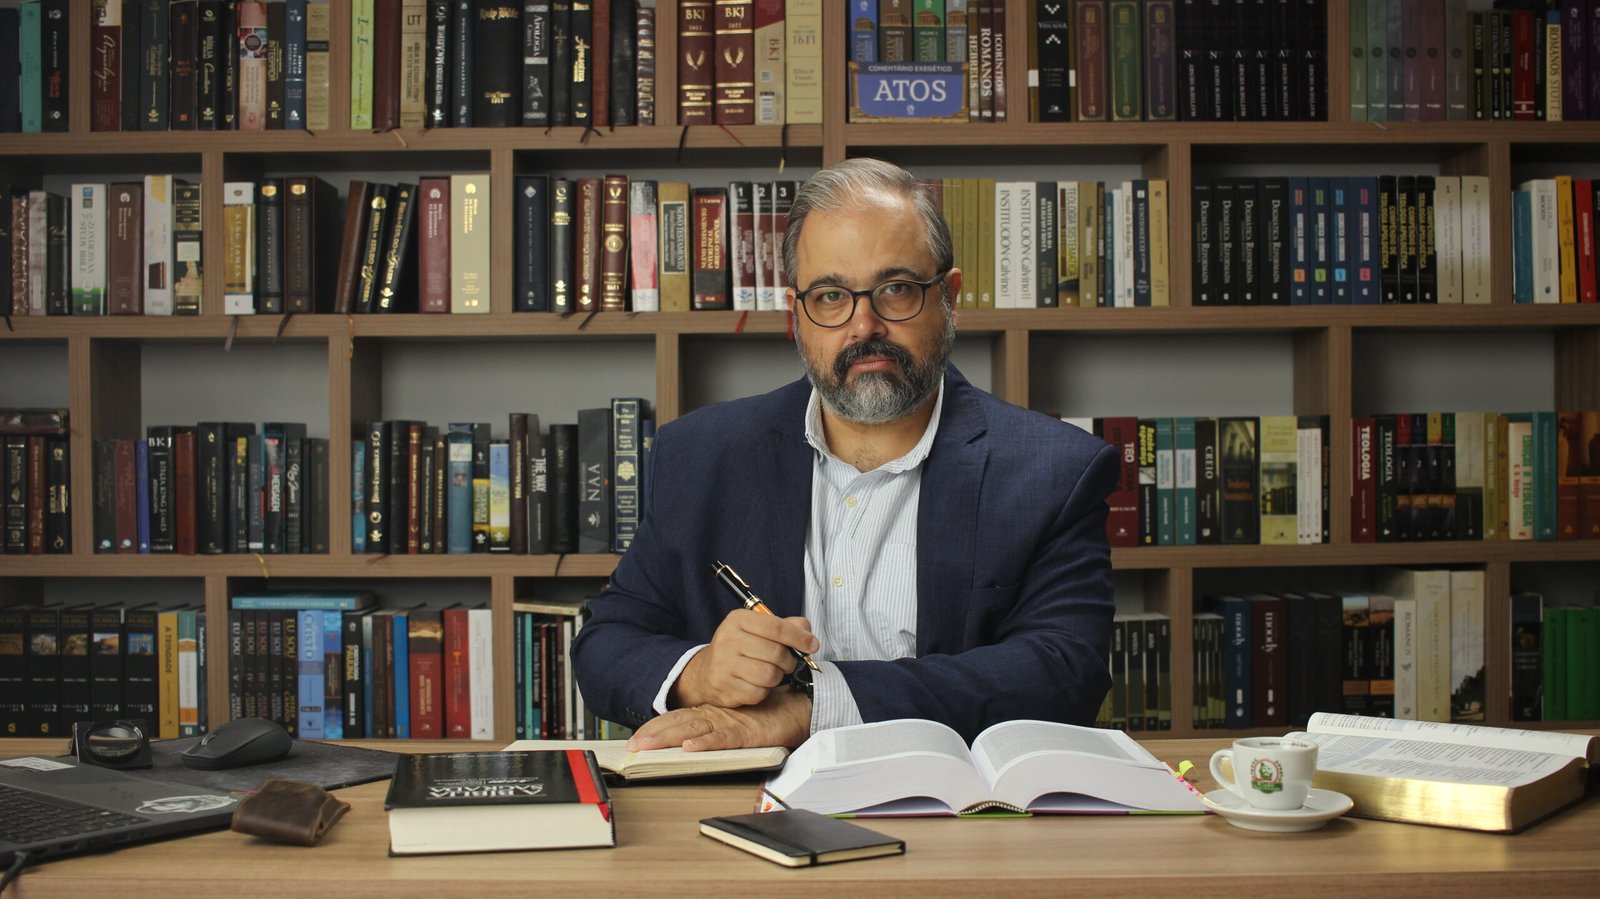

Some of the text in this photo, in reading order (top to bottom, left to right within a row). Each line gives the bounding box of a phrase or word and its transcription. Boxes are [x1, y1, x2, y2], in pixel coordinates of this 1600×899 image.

[685, 9, 705, 21] BKJ
[725, 7, 744, 19] BKJ
[533, 14, 543, 57] APOLOGIA
[767, 37, 781, 62] BKJ
[793, 34, 816, 46] 1611
[868, 64, 953, 72] COMENTÁRIO EXEGÉTICO
[968, 35, 978, 89] HEBREUS
[981, 27, 992, 97] ROMANOS
[1549, 26, 1561, 110] ROMANOS STOTT
[872, 79, 948, 102] ATOS
[738, 187, 744, 197] 1
[780, 187, 787, 197] 3
[1067, 187, 1077, 224] TEOLOGIA
[1000, 190, 1012, 255] INSTITUCIÓN
[1020, 189, 1033, 255] INSTITUCIÓN
[87, 220, 96, 274] ZONDERVAN
[1000, 257, 1011, 293] Calvino
[1020, 257, 1032, 292] Calvino
[148, 436, 172, 448] BKJ
[1361, 426, 1370, 480] TEOLOGIA
[1385, 430, 1393, 482] TEOLOGIA
[535, 457, 546, 492] THE WAY
[1205, 445, 1213, 480] CREIO
[587, 463, 602, 502] NAA
[1523, 483, 1534, 527] TEOLOGIA
[233, 622, 241, 656] EU SOU
[247, 621, 255, 655] EU SOU
[259, 621, 267, 655] EU SOU
[273, 622, 281, 656] EU SOU
[287, 618, 296, 658] EU SOU
[304, 614, 314, 660] CRISTO
